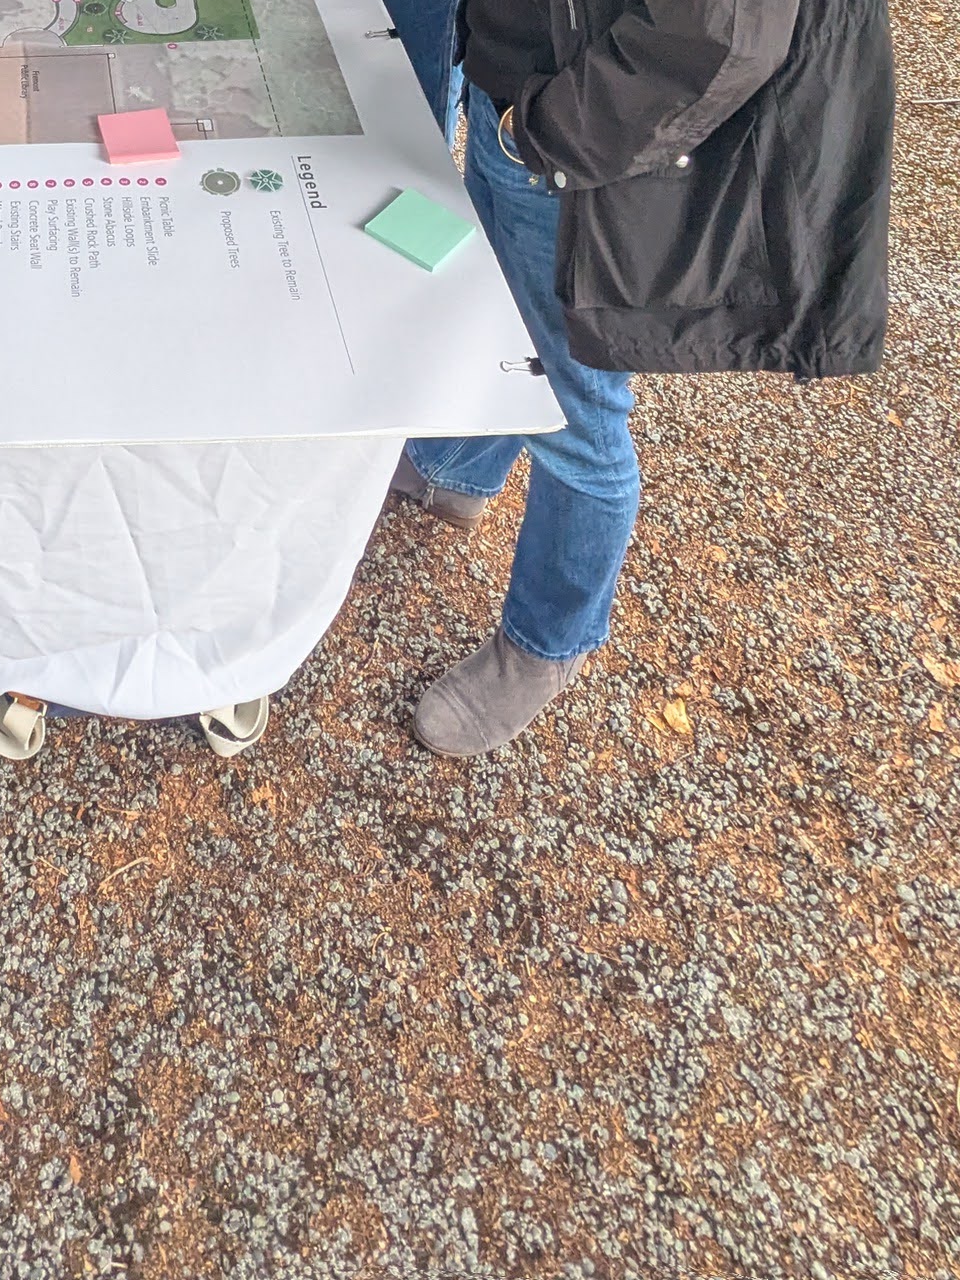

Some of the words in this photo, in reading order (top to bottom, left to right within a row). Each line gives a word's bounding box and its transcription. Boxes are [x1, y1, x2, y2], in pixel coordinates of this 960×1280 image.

[21, 65, 29, 80] Public
[32, 71, 40, 91] Fremont
[20, 81, 29, 98] Library
[297, 156, 327, 209] Legend
[8, 201, 21, 228] Existing
[29, 200, 40, 232] Concrete
[45, 200, 59, 215] Play
[65, 199, 77, 226] Existing
[84, 198, 97, 228] Crushed
[102, 197, 114, 217] Stone
[122, 197, 135, 222] Hillside
[158, 197, 171, 216] Picnic
[140, 197, 155, 244] Embankment
[162, 218, 175, 237] Table
[220, 211, 238, 246] Proposed
[269, 210, 285, 239] Existing
[10, 230, 22, 250] Stairs
[29, 234, 41, 250] Seat
[46, 217, 60, 251] Surfacing
[67, 228, 80, 254] Wall(s)
[86, 230, 99, 249] Rock
[105, 219, 117, 247] Abacus
[123, 224, 136, 247] Loops
[88, 250, 101, 268] Path
[146, 247, 159, 266] Slide
[228, 248, 240, 268] Trees
[277, 241, 290, 257] Tree
[30, 252, 42, 269] Wall
[281, 259, 292, 267] to
[70, 267, 83, 297] Remain
[285, 270, 302, 300] Remain
